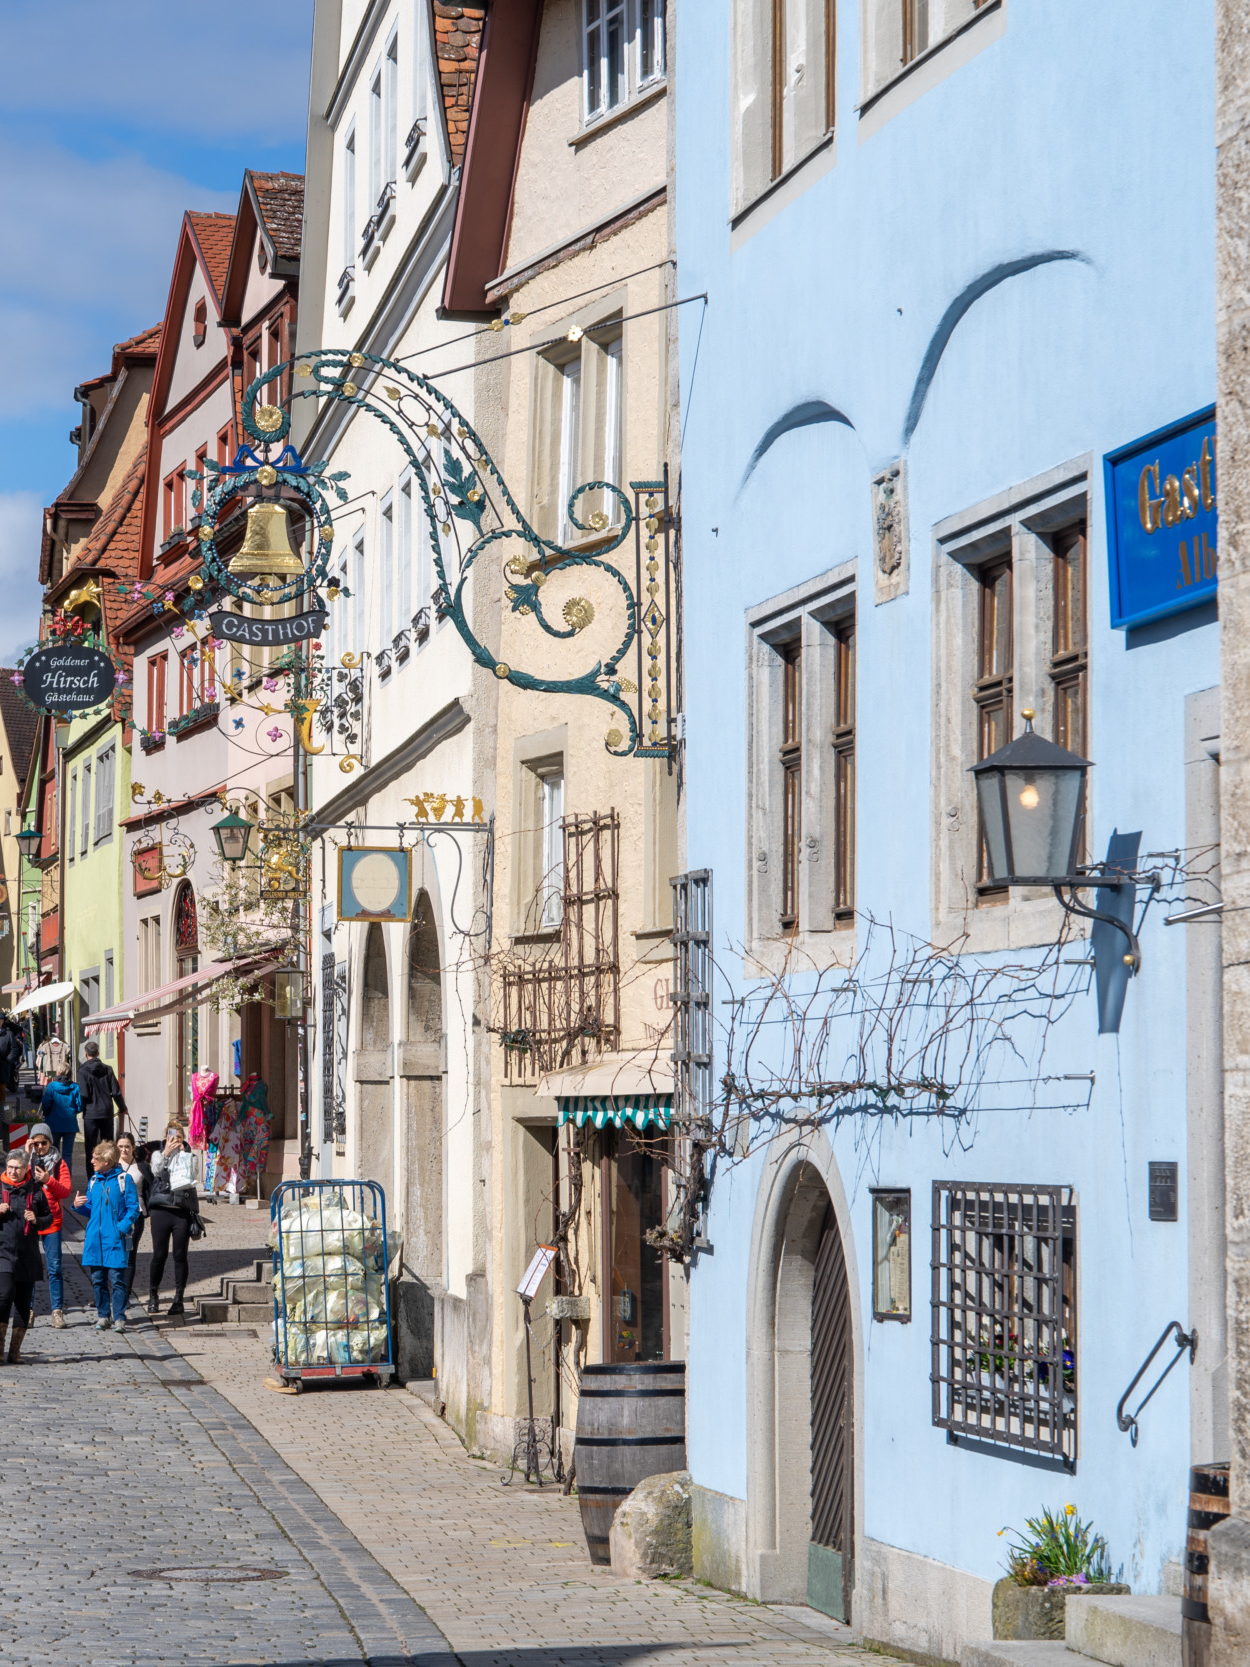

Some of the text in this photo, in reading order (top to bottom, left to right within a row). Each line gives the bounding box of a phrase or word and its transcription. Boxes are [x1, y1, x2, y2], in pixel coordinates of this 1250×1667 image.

[1138, 436, 1217, 535] Gast
[1176, 531, 1219, 590] Alb
[222, 616, 317, 641] GASTHOF
[50, 656, 90, 668] Goldener
[40, 670, 100, 688] Hirsch
[45, 691, 95, 705] Gästehaus
